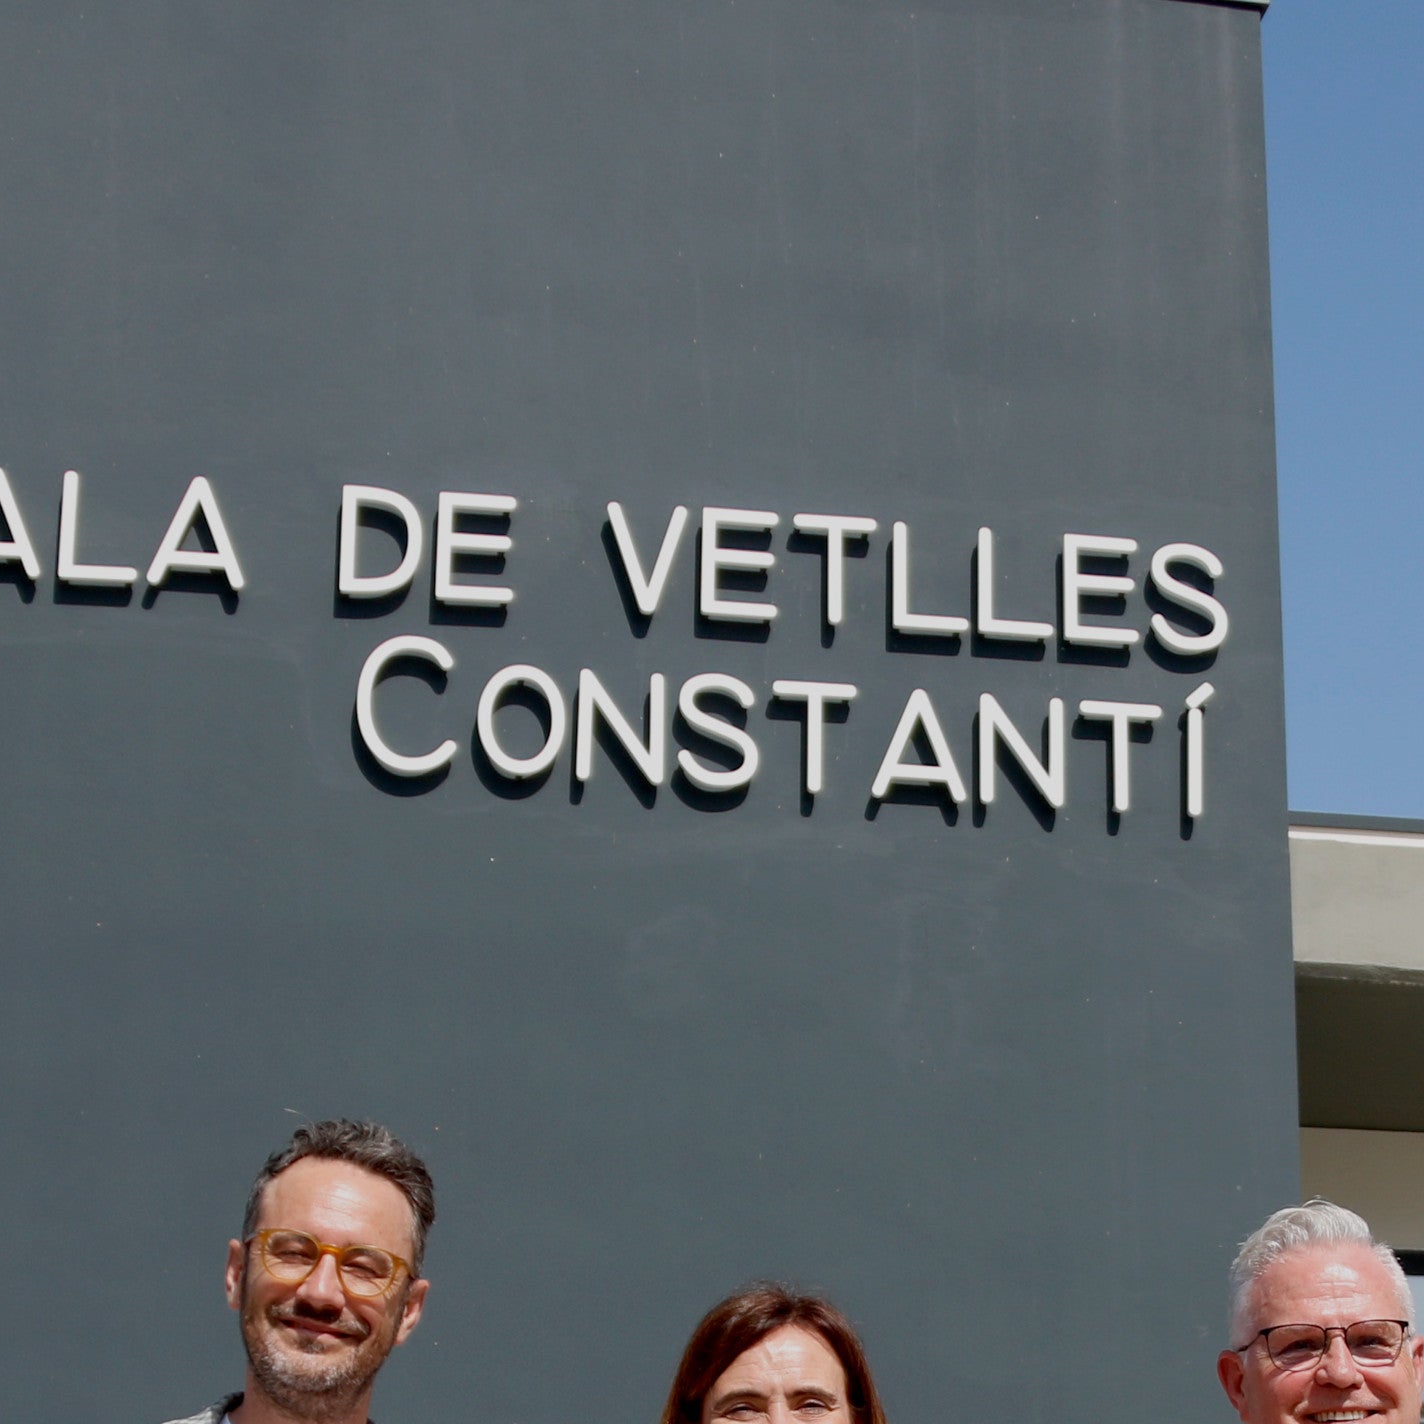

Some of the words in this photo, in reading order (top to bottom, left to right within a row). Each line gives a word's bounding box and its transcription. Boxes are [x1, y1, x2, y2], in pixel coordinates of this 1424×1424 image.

[340, 485, 518, 604] DE
[607, 502, 1229, 654] VETLLES
[357, 636, 1215, 817] CONSTANTÍ
